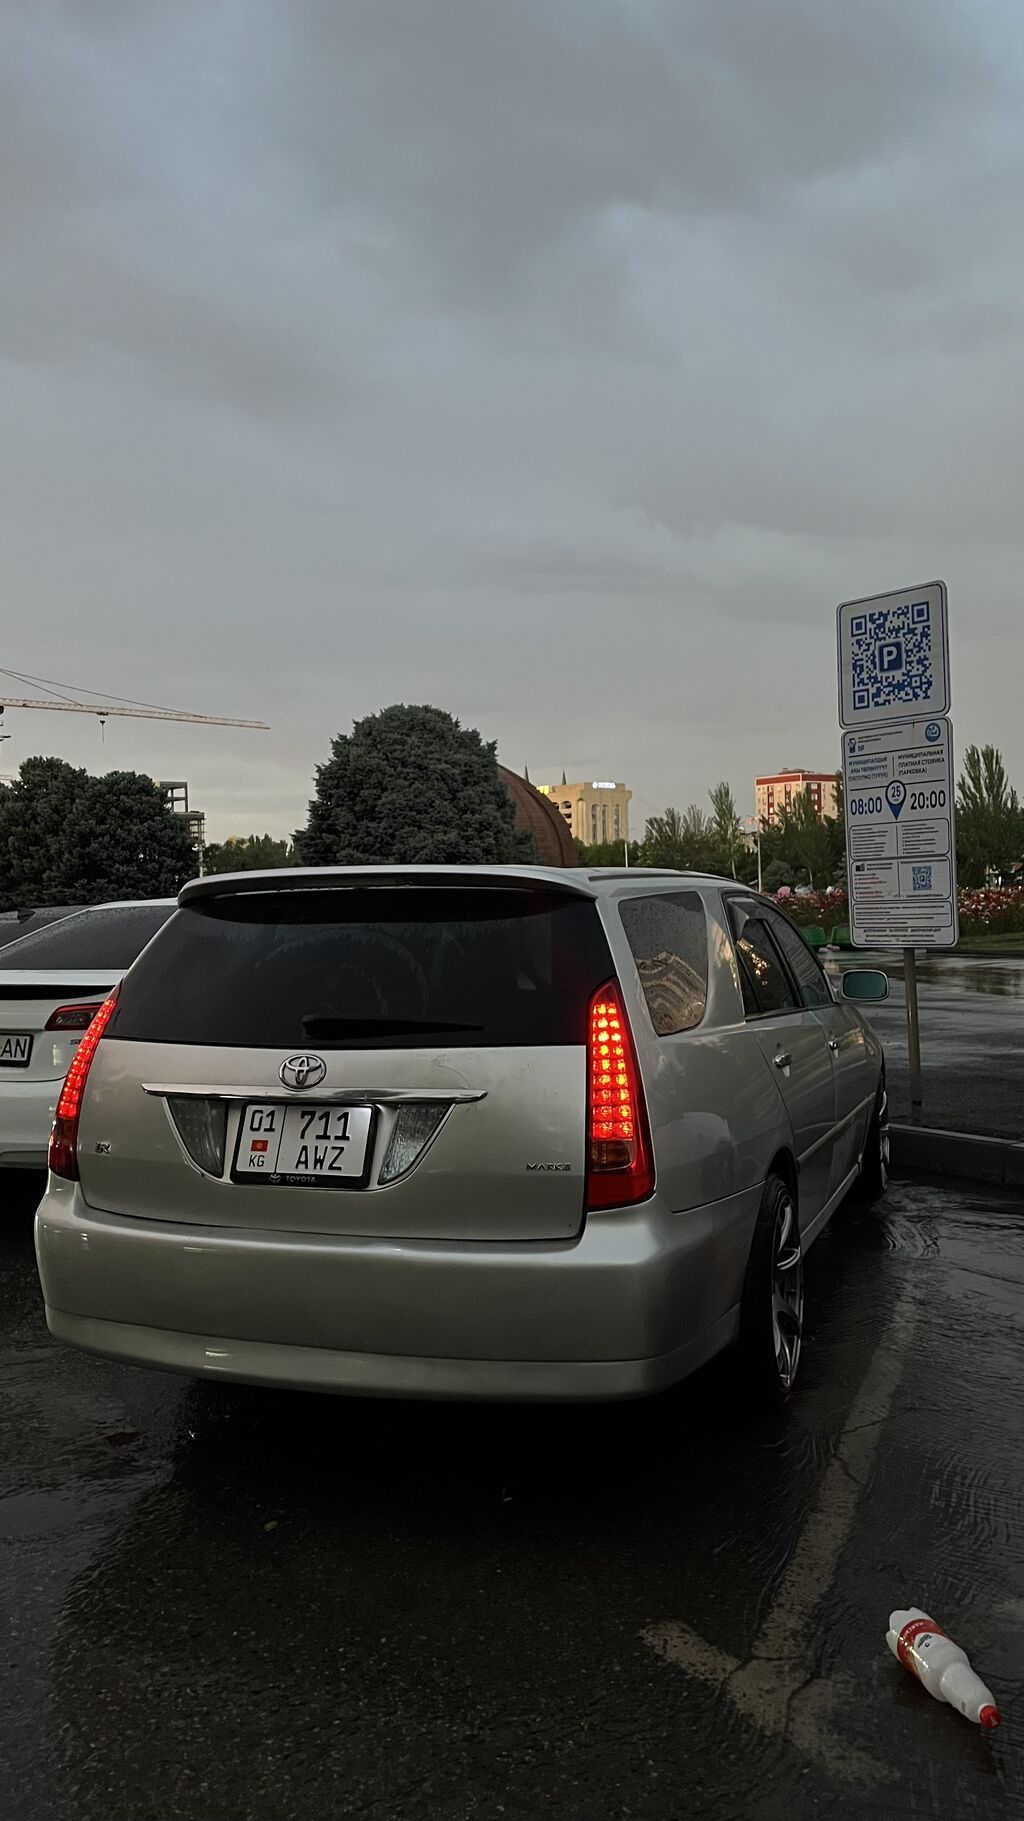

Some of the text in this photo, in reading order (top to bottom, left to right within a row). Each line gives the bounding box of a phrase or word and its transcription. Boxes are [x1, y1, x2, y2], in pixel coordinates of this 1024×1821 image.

[883, 645, 898, 670] P
[898, 757, 945, 768] ПЛАТНАЯ СТОЯНКА
[891, 785, 901, 798] 25
[910, 789, 946, 810] 20:00
[850, 797, 883, 816] 08:00
[249, 1108, 351, 1141] 01 711
[248, 1145, 346, 1171] KG AWZ
[286, 1175, 316, 1183] TOYOTA
